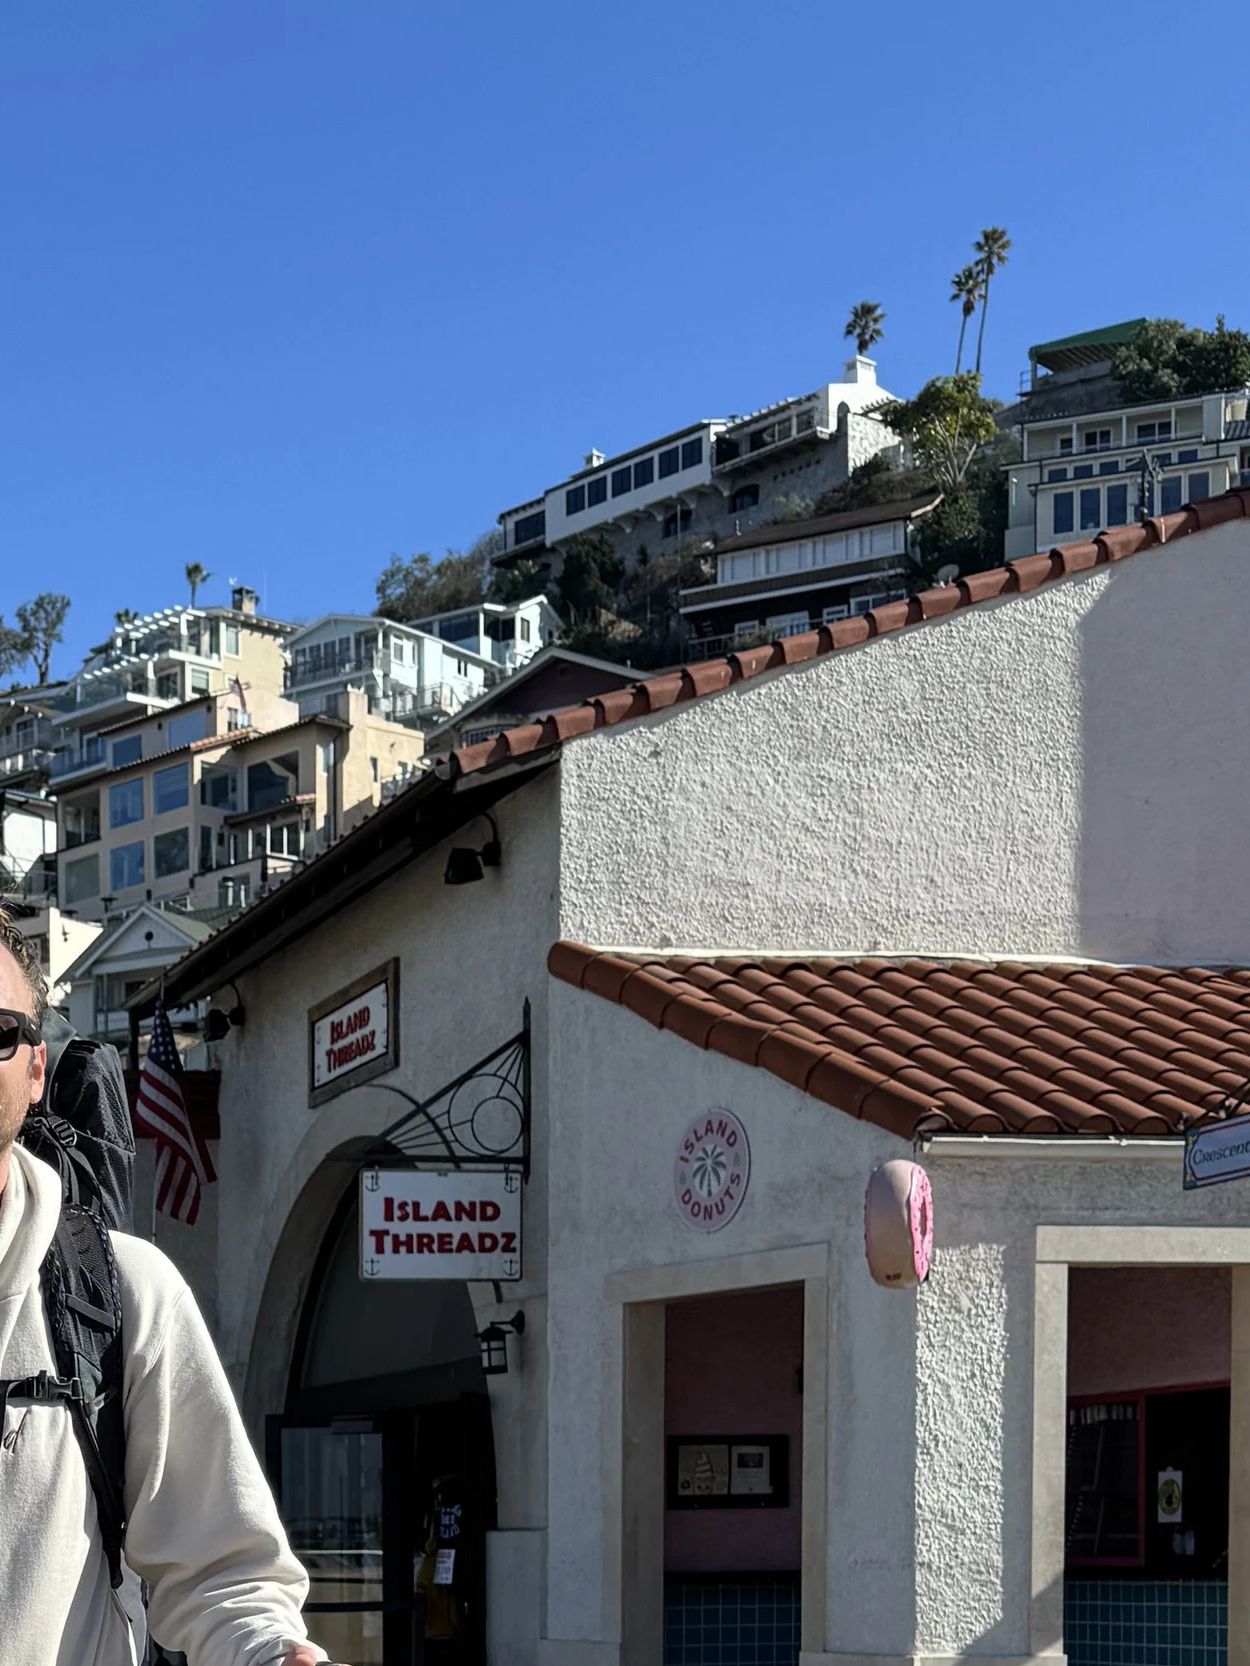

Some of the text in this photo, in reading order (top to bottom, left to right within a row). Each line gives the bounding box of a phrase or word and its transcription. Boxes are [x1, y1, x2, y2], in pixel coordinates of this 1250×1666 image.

[331, 1006, 370, 1045] ISLAND
[679, 1119, 737, 1164] ISLAND
[383, 1197, 501, 1222] ISLAND
[680, 1172, 741, 1221] DONUTS
[369, 1229, 517, 1254] THREADZ
